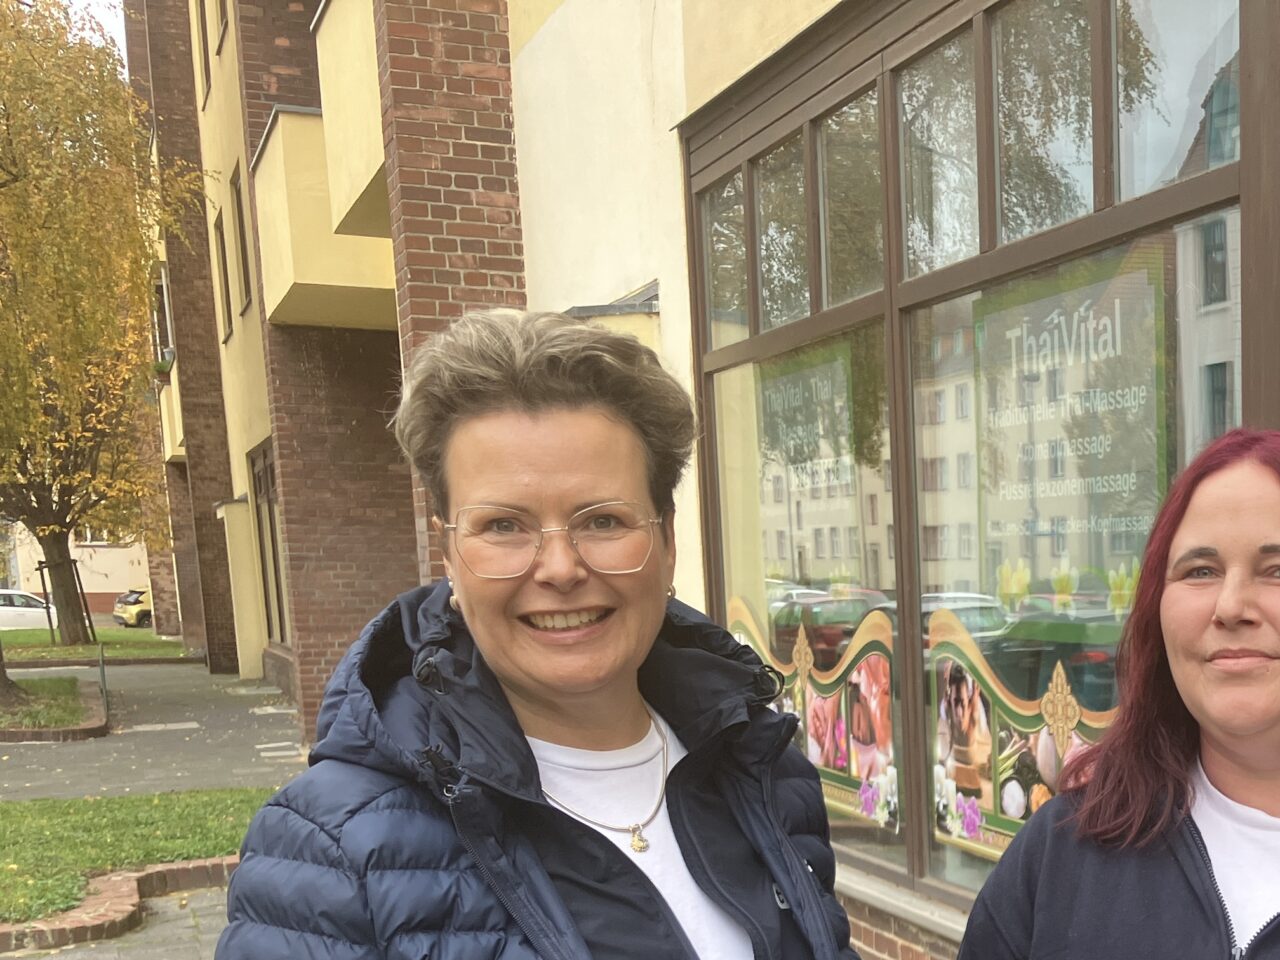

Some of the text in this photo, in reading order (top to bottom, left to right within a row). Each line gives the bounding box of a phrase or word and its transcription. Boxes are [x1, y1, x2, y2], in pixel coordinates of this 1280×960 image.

[1005, 298, 1122, 379] ThaiVital
[810, 371, 832, 402] Thai
[1057, 384, 1147, 419] Thai-Massage
[999, 472, 1137, 501] Fussrelexzonenmassage
